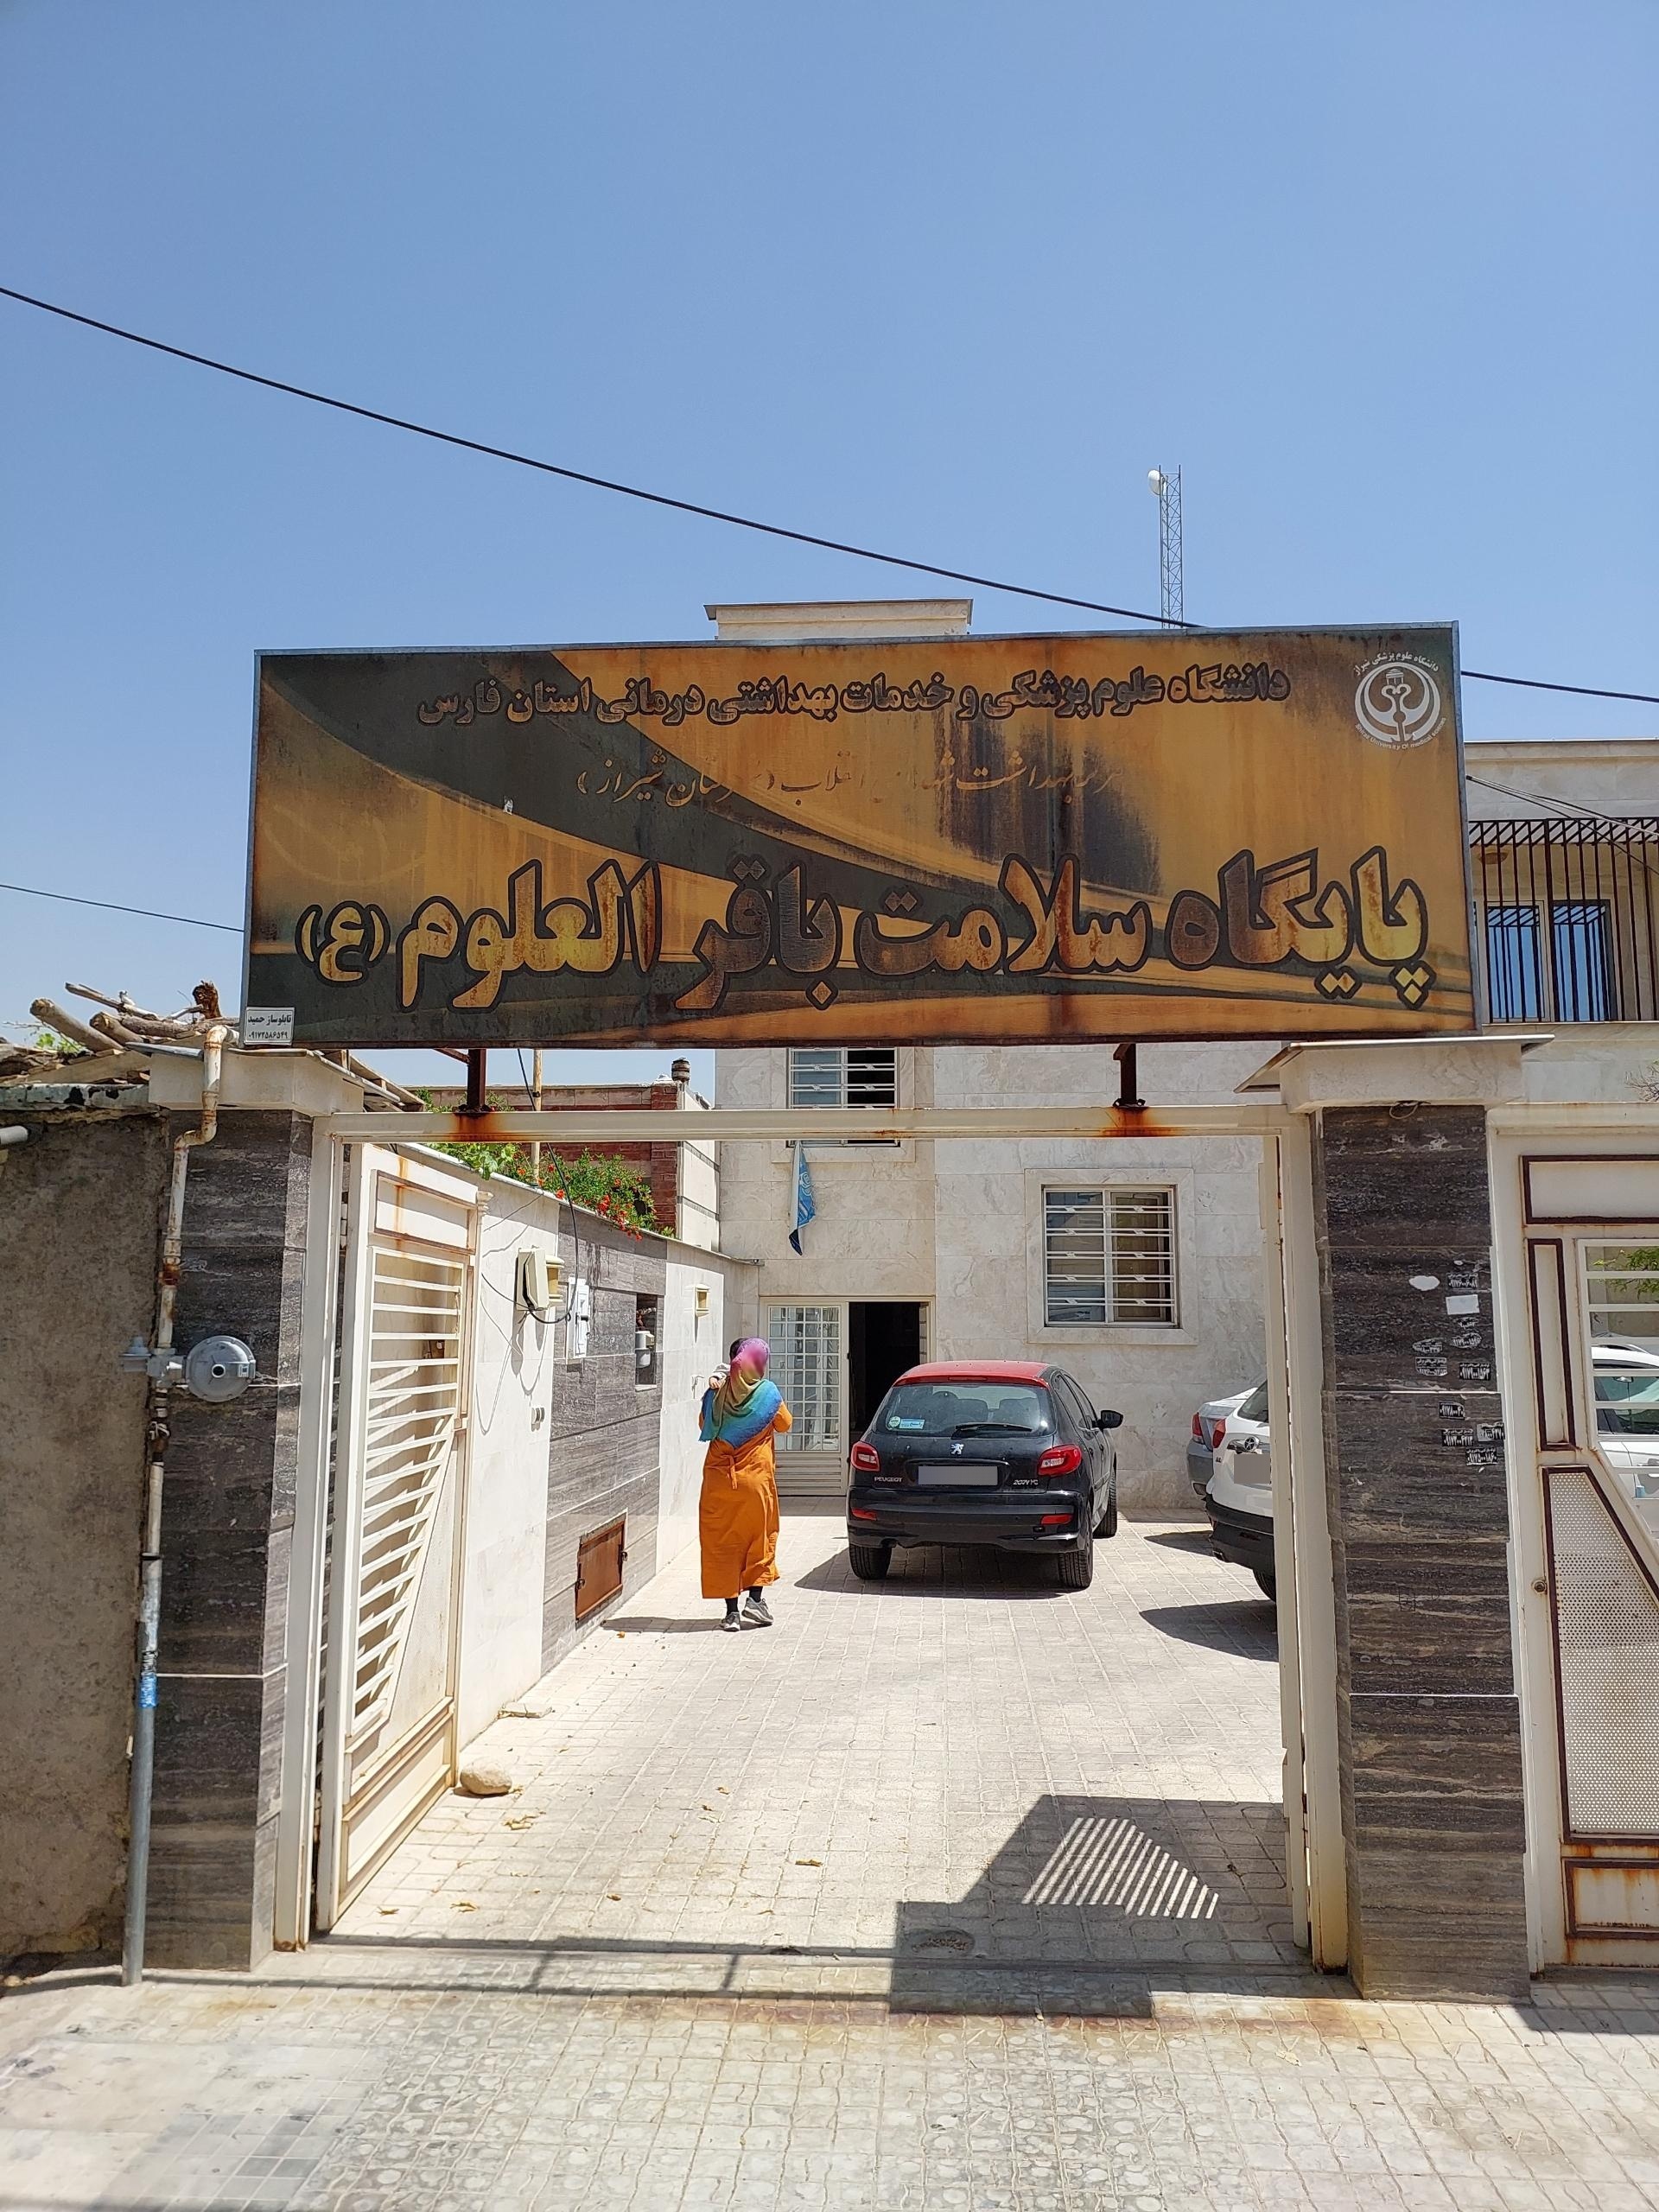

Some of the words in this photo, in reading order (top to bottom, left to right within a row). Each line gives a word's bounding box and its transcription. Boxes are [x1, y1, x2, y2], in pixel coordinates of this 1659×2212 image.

[1353, 658, 1371, 677] شیراز
[1371, 652, 1395, 665] پزشکی
[1395, 652, 1413, 661] علوم
[1414, 655, 1440, 671] دانشگاه
[416, 678, 501, 725] فارس
[506, 677, 593, 724] استان
[595, 677, 706, 726] درمانی
[708, 675, 838, 723] بهداشتی
[840, 671, 952, 714] خدمات
[956, 685, 980, 721] و
[979, 670, 1090, 720] پزشکی
[1092, 665, 1165, 717] علوم
[1167, 662, 1291, 703] دانشگاه
[395, 858, 662, 1013] العلوم
[672, 853, 844, 1011] باقر
[853, 852, 1154, 976] سلامت
[1164, 845, 1437, 1009] پایگاه
[294, 899, 391, 986] (ع)
[247, 1015, 265, 1026] حمید
